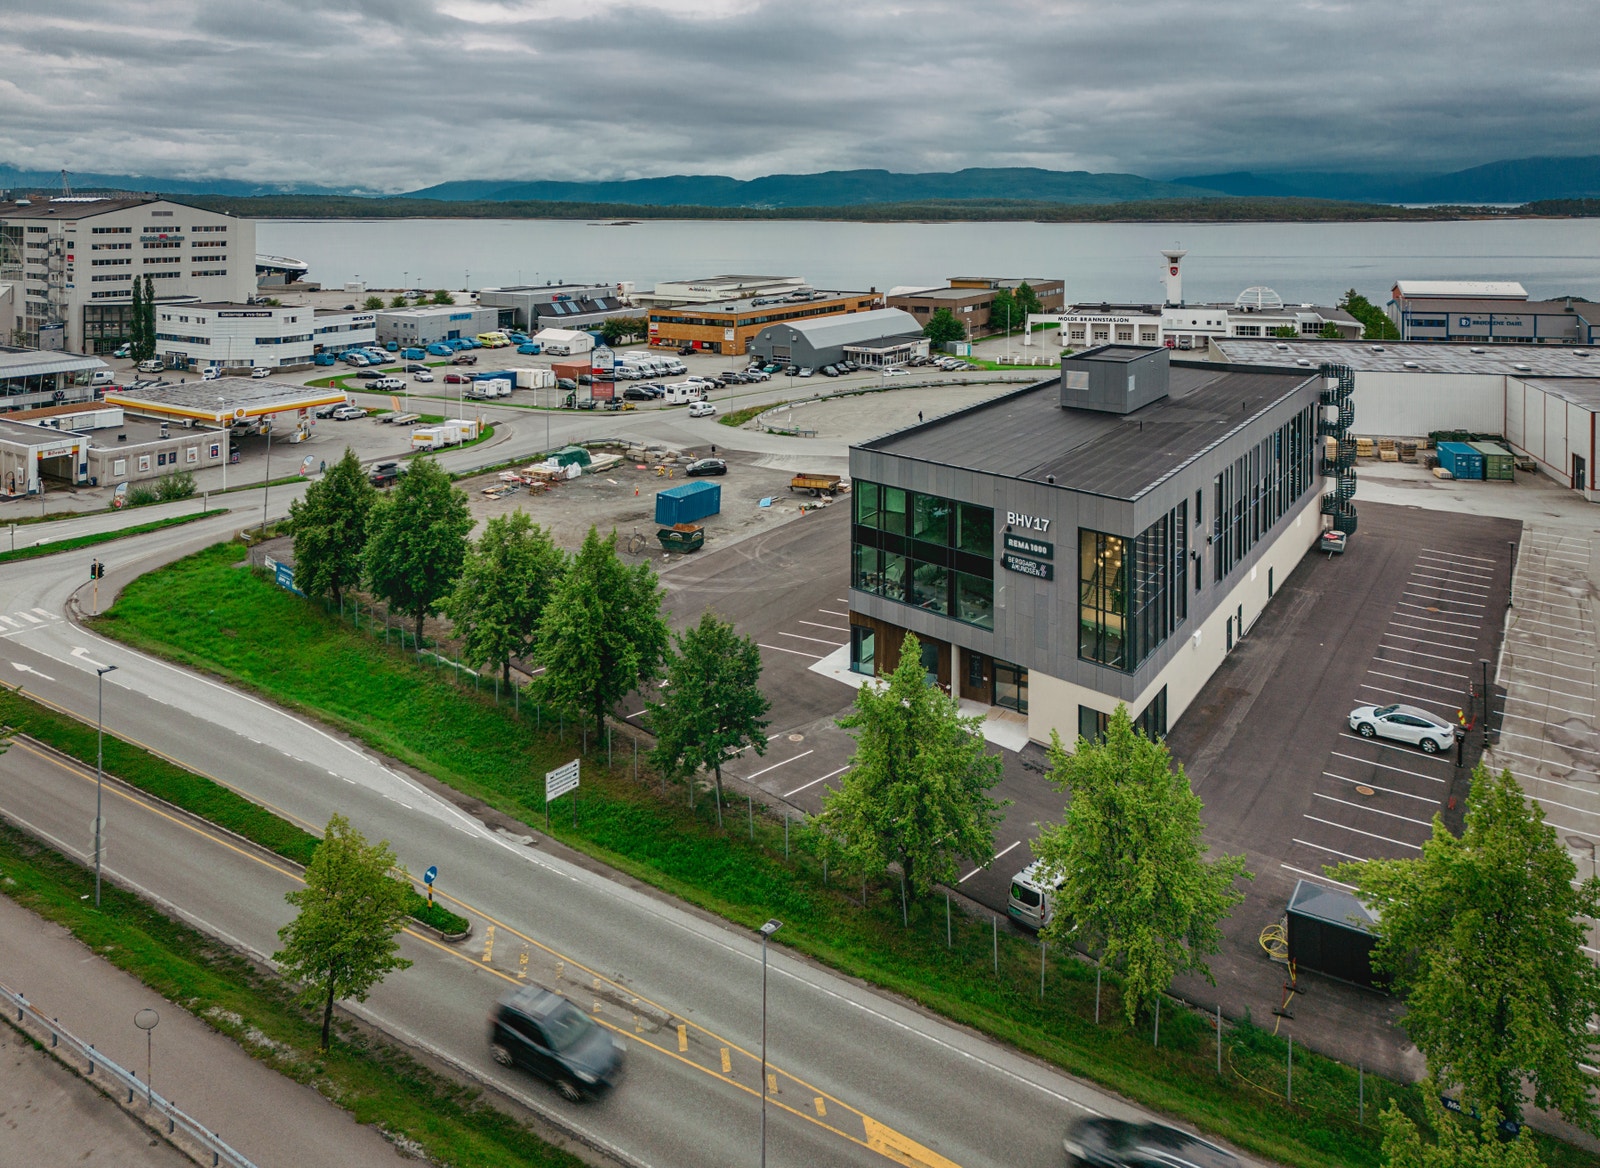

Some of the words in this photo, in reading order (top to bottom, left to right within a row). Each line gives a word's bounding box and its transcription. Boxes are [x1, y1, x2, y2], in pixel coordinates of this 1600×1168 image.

[1007, 511, 1050, 532] BHV17
[1008, 539, 1030, 550] REMA
[1030, 543, 1047, 554] 1000
